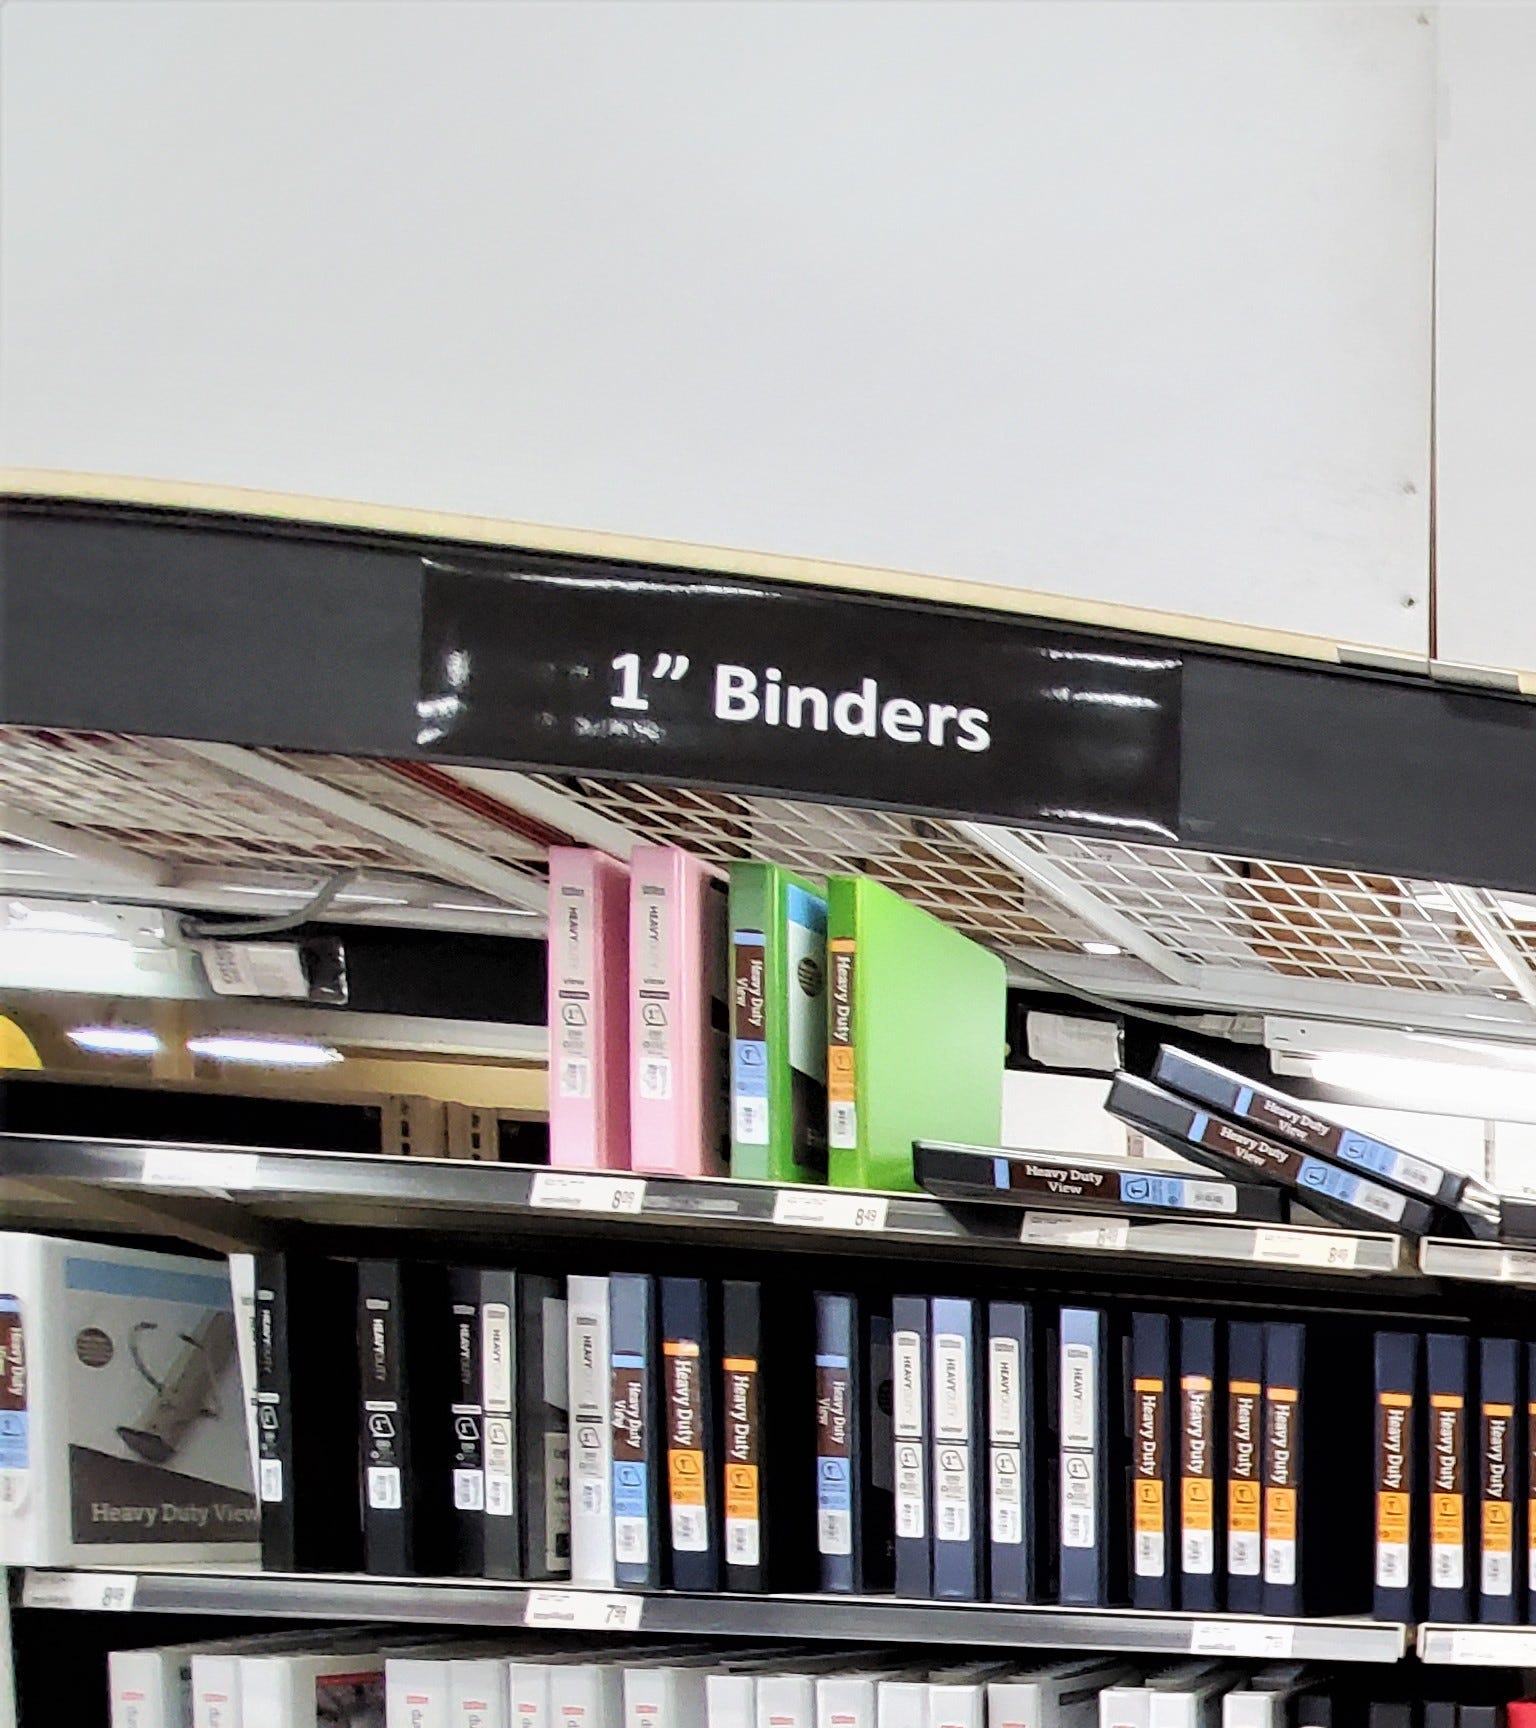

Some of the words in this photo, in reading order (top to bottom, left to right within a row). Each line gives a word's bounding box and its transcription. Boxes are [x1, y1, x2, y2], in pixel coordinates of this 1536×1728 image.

[714, 662, 991, 754] Binders
[833, 956, 851, 1004] Heavy
[832, 1005, 850, 1043] Duty
[1234, 1146, 1266, 1167] View
[1048, 1180, 1082, 1196] View
[672, 1360, 692, 1406] Heavy
[729, 1375, 749, 1426] Heavy
[673, 1409, 693, 1446] Duty
[730, 1424, 749, 1460] Duty
[90, 1501, 157, 1526] Heavy
[161, 1503, 209, 1527] Duty
[222, 1503, 261, 1523] View
